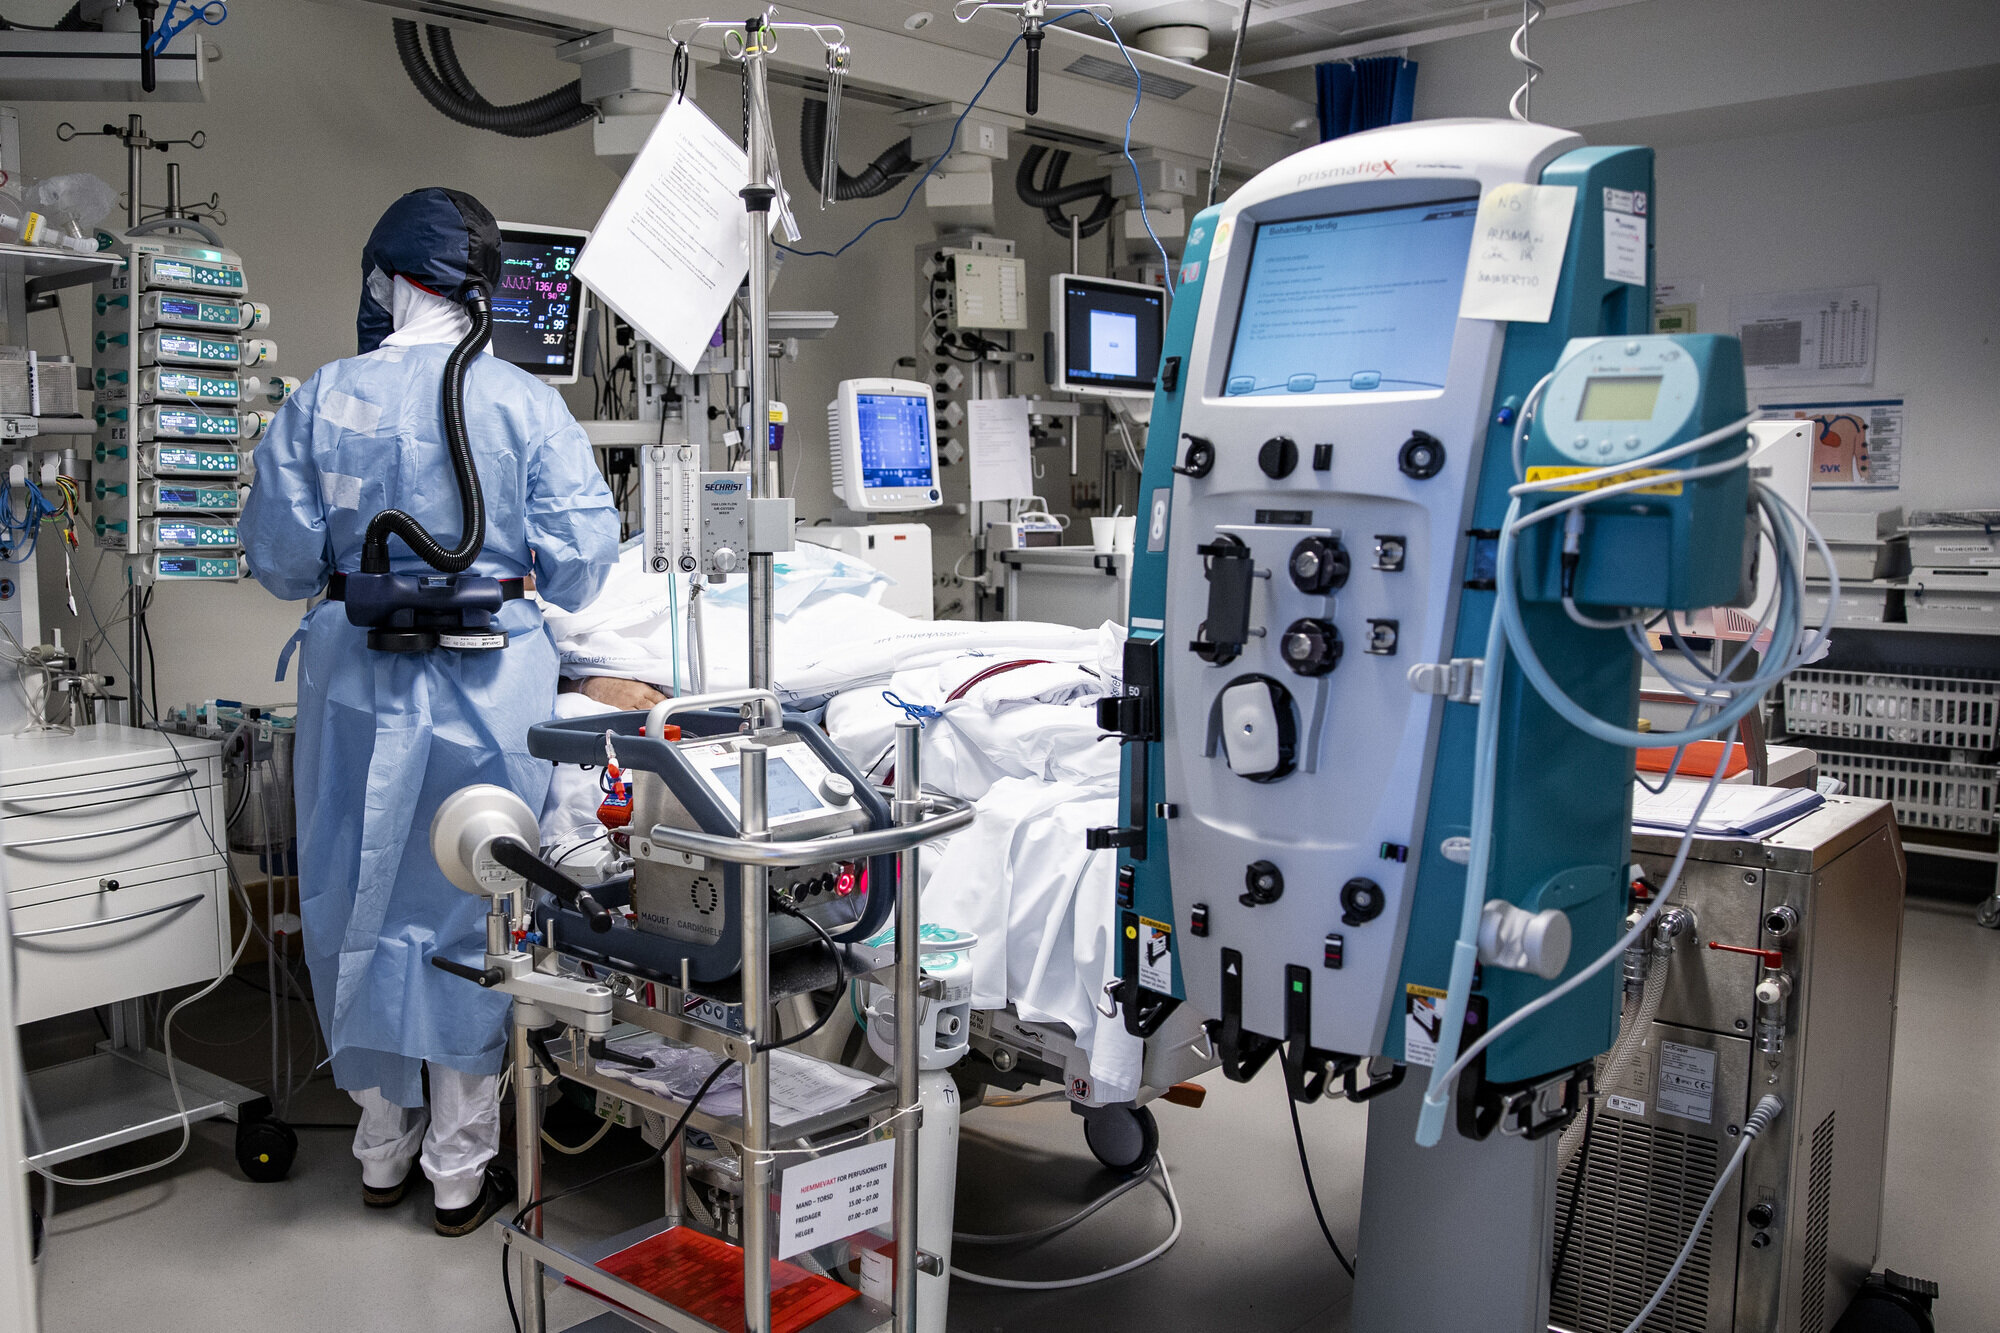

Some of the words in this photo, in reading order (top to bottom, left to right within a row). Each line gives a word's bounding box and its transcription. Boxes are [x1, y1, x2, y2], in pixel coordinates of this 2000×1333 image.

[1269, 222, 1313, 236] Behandling
[554, 257, 571, 271] 85
[556, 282, 568, 293] 69
[553, 319, 565, 330] 99
[542, 333, 564, 345] 36.7
[1820, 463, 1841, 473] SVK
[704, 483, 743, 492] SECHRIST
[1128, 685, 1140, 697] 50
[641, 912, 670, 926] MAQUET
[800, 1177, 837, 1194] HJEMMEVAKT
[837, 1175, 848, 1183] FOR
[848, 1163, 887, 1180] PERFUSJONISTER
[795, 1200, 812, 1210] MAND
[817, 1193, 834, 1203] TORSD
[849, 1183, 862, 1193] 18.00
[866, 1179, 880, 1188] 07.00
[795, 1211, 822, 1224] FREDAGER
[848, 1197, 862, 1208] 15.00
[866, 1193, 879, 1202] 07.00
[794, 1227, 814, 1239] HELGER
[847, 1211, 861, 1222] 07.00
[865, 1206, 879, 1216] 07.00
